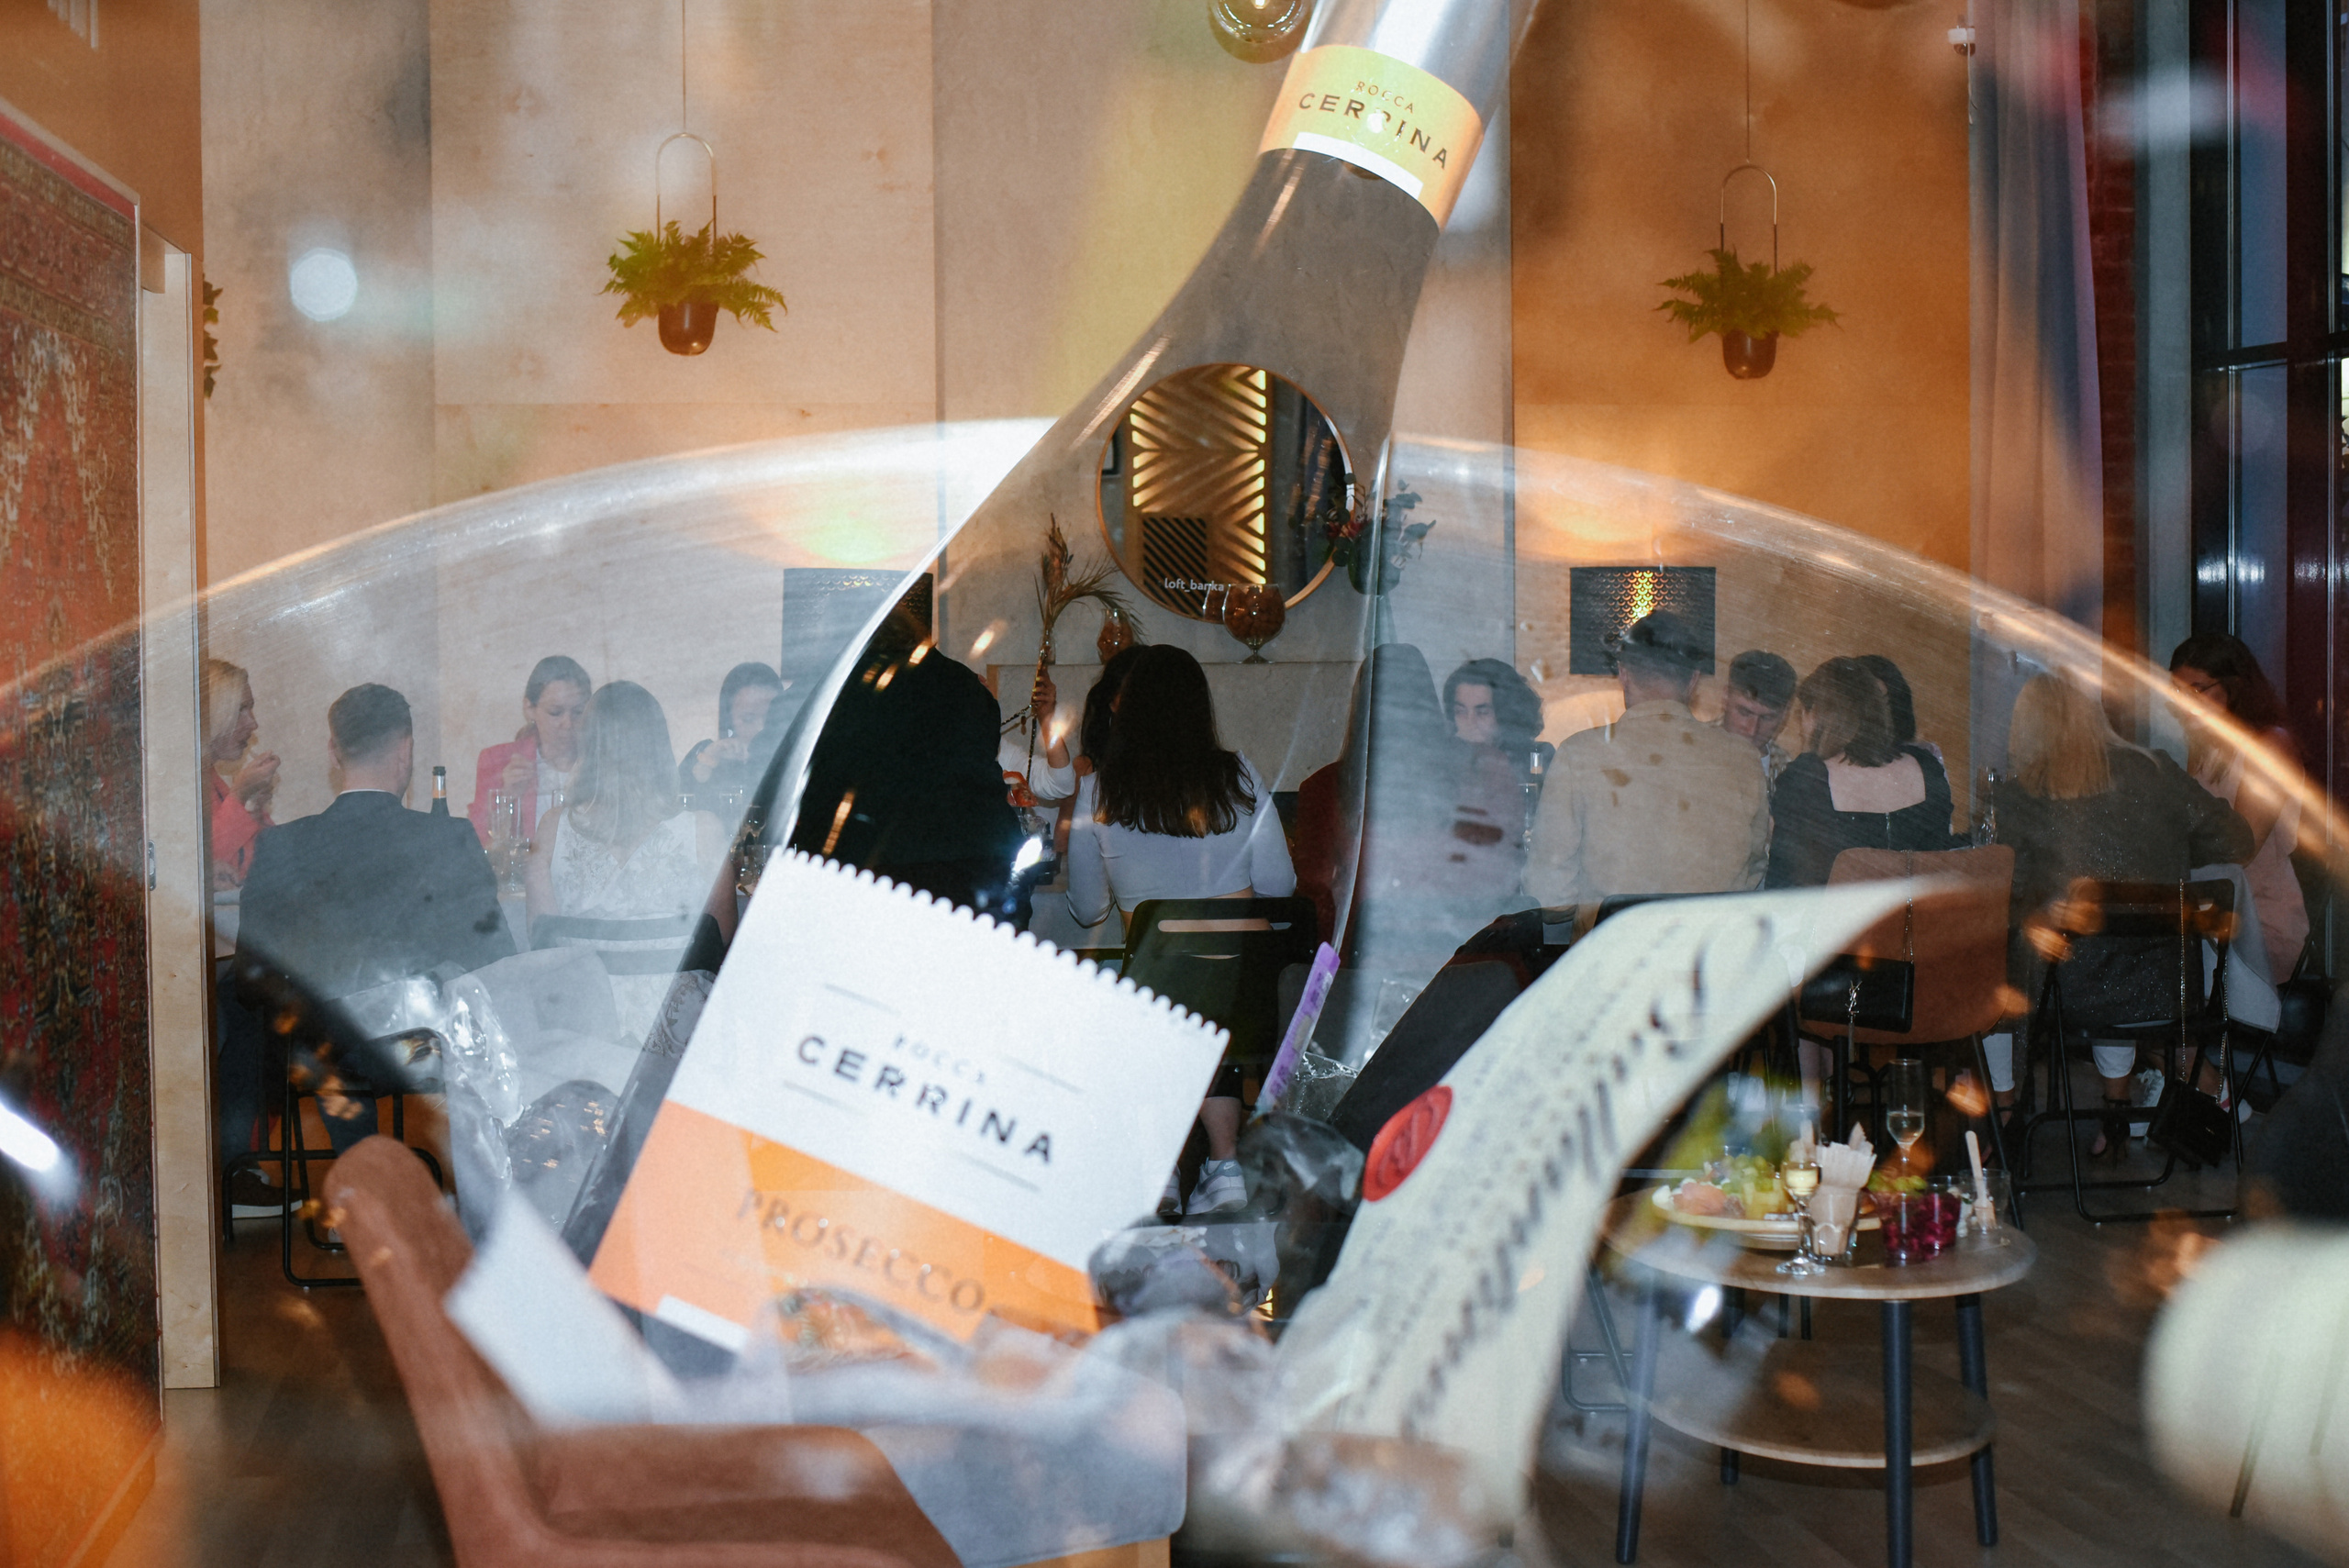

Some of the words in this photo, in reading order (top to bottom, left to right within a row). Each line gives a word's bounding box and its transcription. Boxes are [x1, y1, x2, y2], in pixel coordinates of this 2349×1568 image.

[1355, 81, 1414, 114] ROCCA
[1163, 577, 1224, 592] loft_banka
[796, 1034, 1052, 1165] CERRINA
[737, 1187, 986, 1315] PROSECCO
